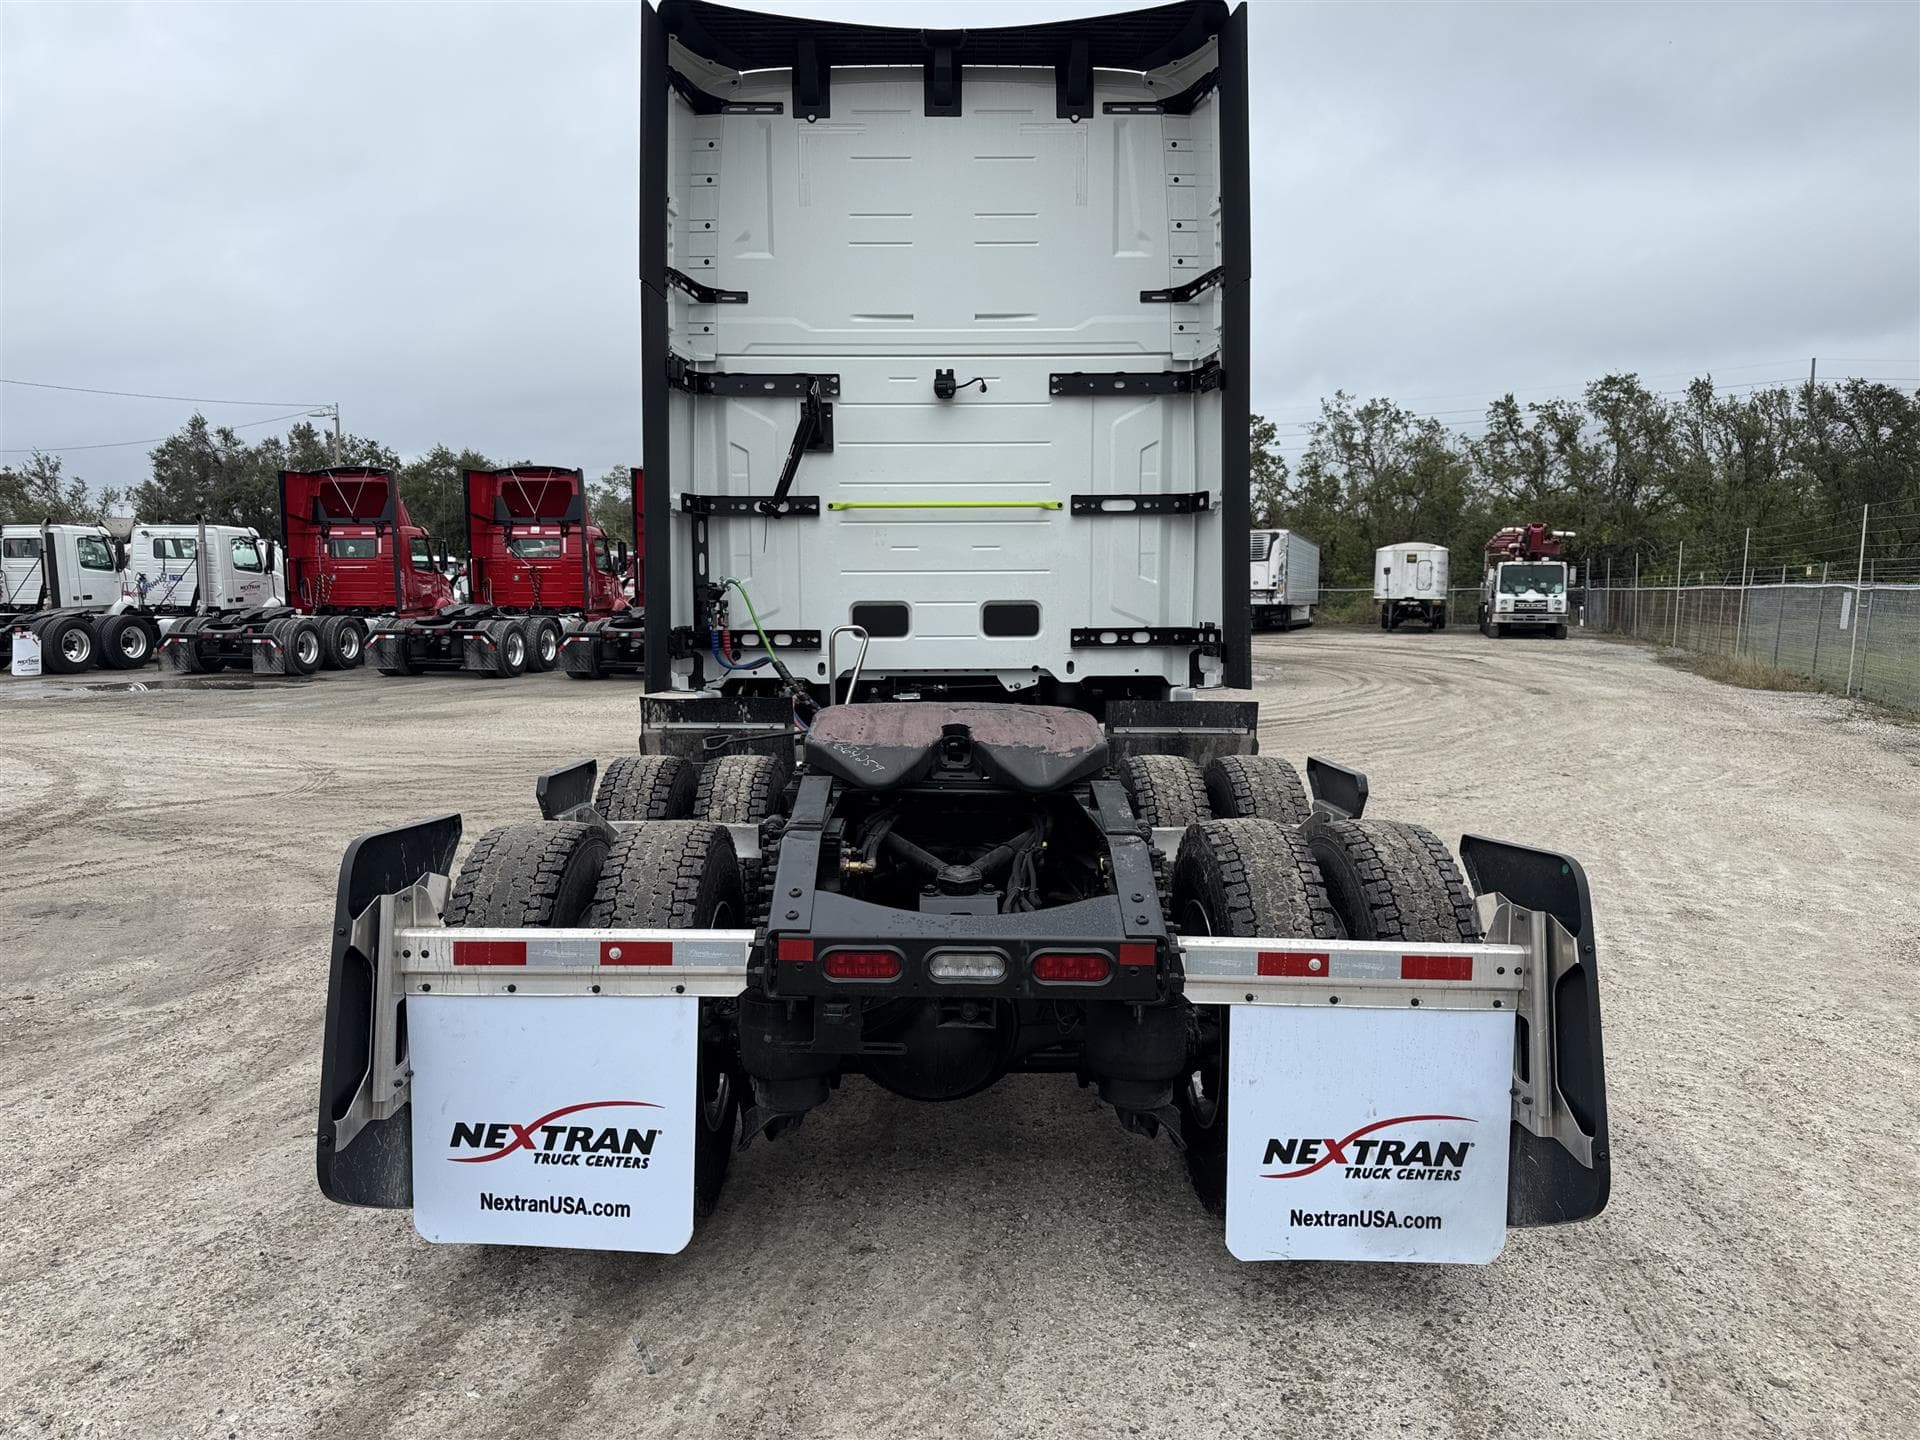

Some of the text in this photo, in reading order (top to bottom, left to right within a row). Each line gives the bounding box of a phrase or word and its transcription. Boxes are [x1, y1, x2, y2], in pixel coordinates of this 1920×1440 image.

[449, 1122, 659, 1156] NEXTRAN
[533, 1152, 650, 1170] TRUCK CENTERS
[1262, 1138, 1470, 1168] NEXTRAN
[1344, 1167, 1462, 1181] TRUCK CENTERS
[480, 1192, 631, 1218] NextranUSA.com
[1290, 1209, 1442, 1230] NextranUSA.com
